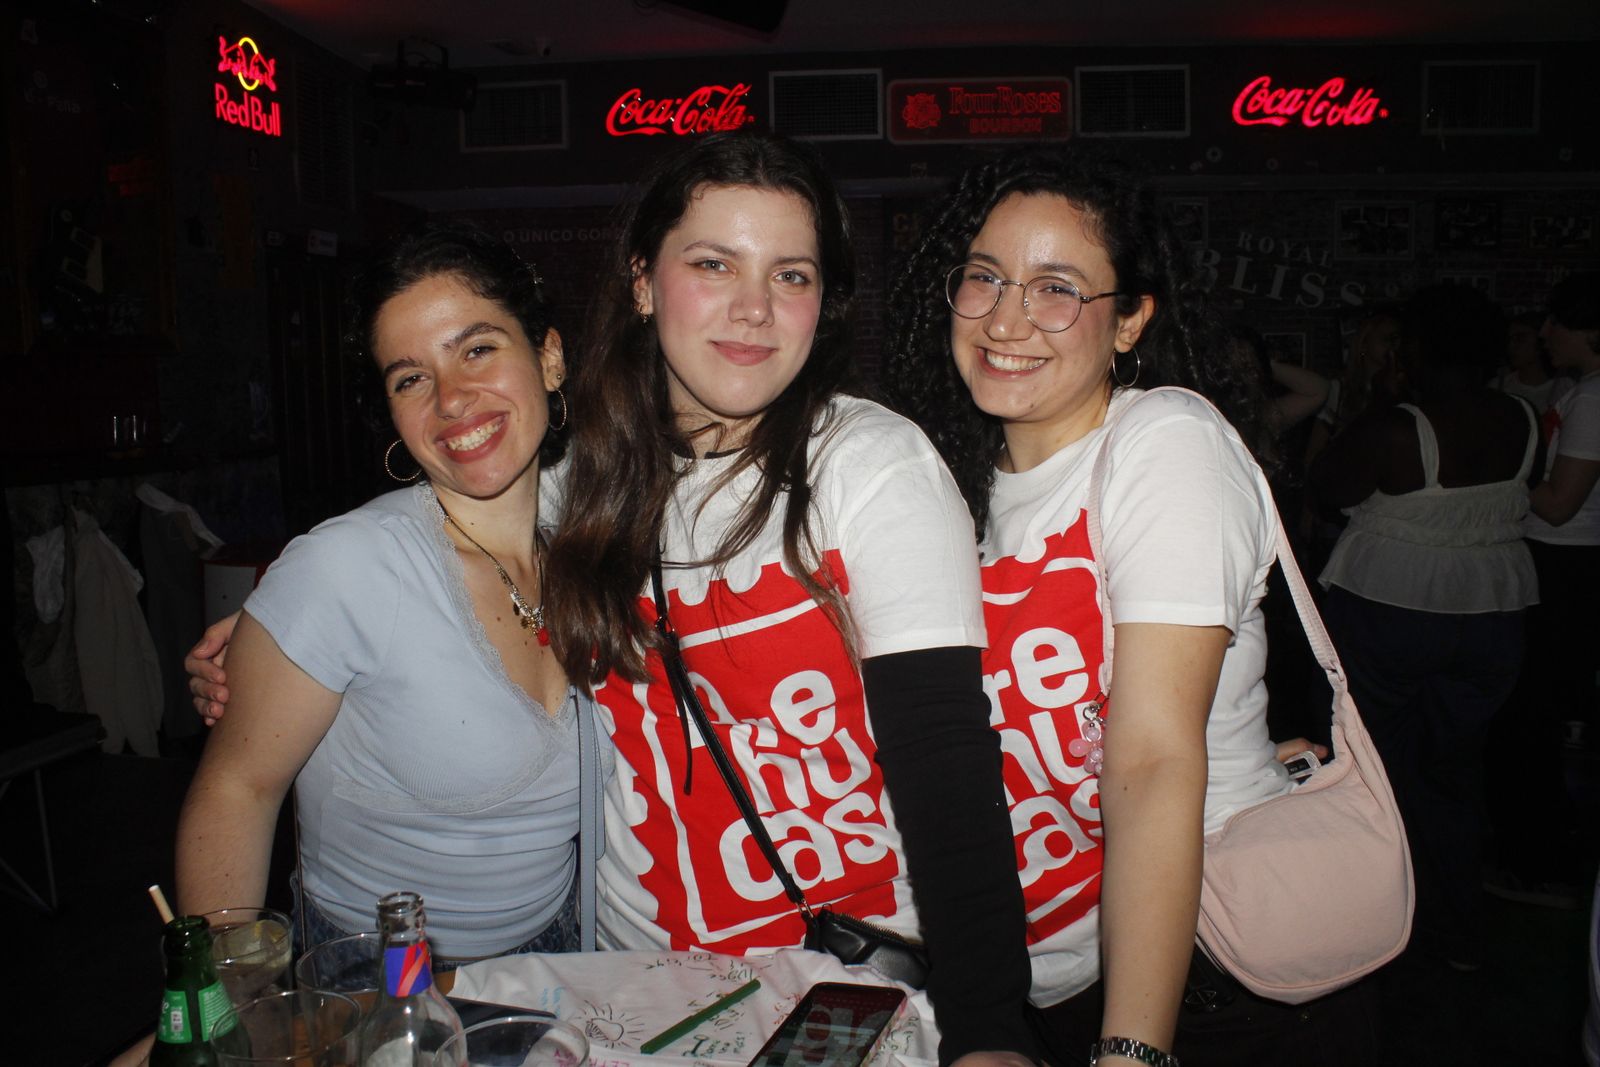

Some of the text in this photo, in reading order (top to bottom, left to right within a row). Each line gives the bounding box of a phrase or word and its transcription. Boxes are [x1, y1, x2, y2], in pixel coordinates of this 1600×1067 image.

[604, 82, 754, 137] Coca-Cola
[1231, 75, 1382, 128] Coca-Cola
[1237, 231, 1332, 269] ROYAL
